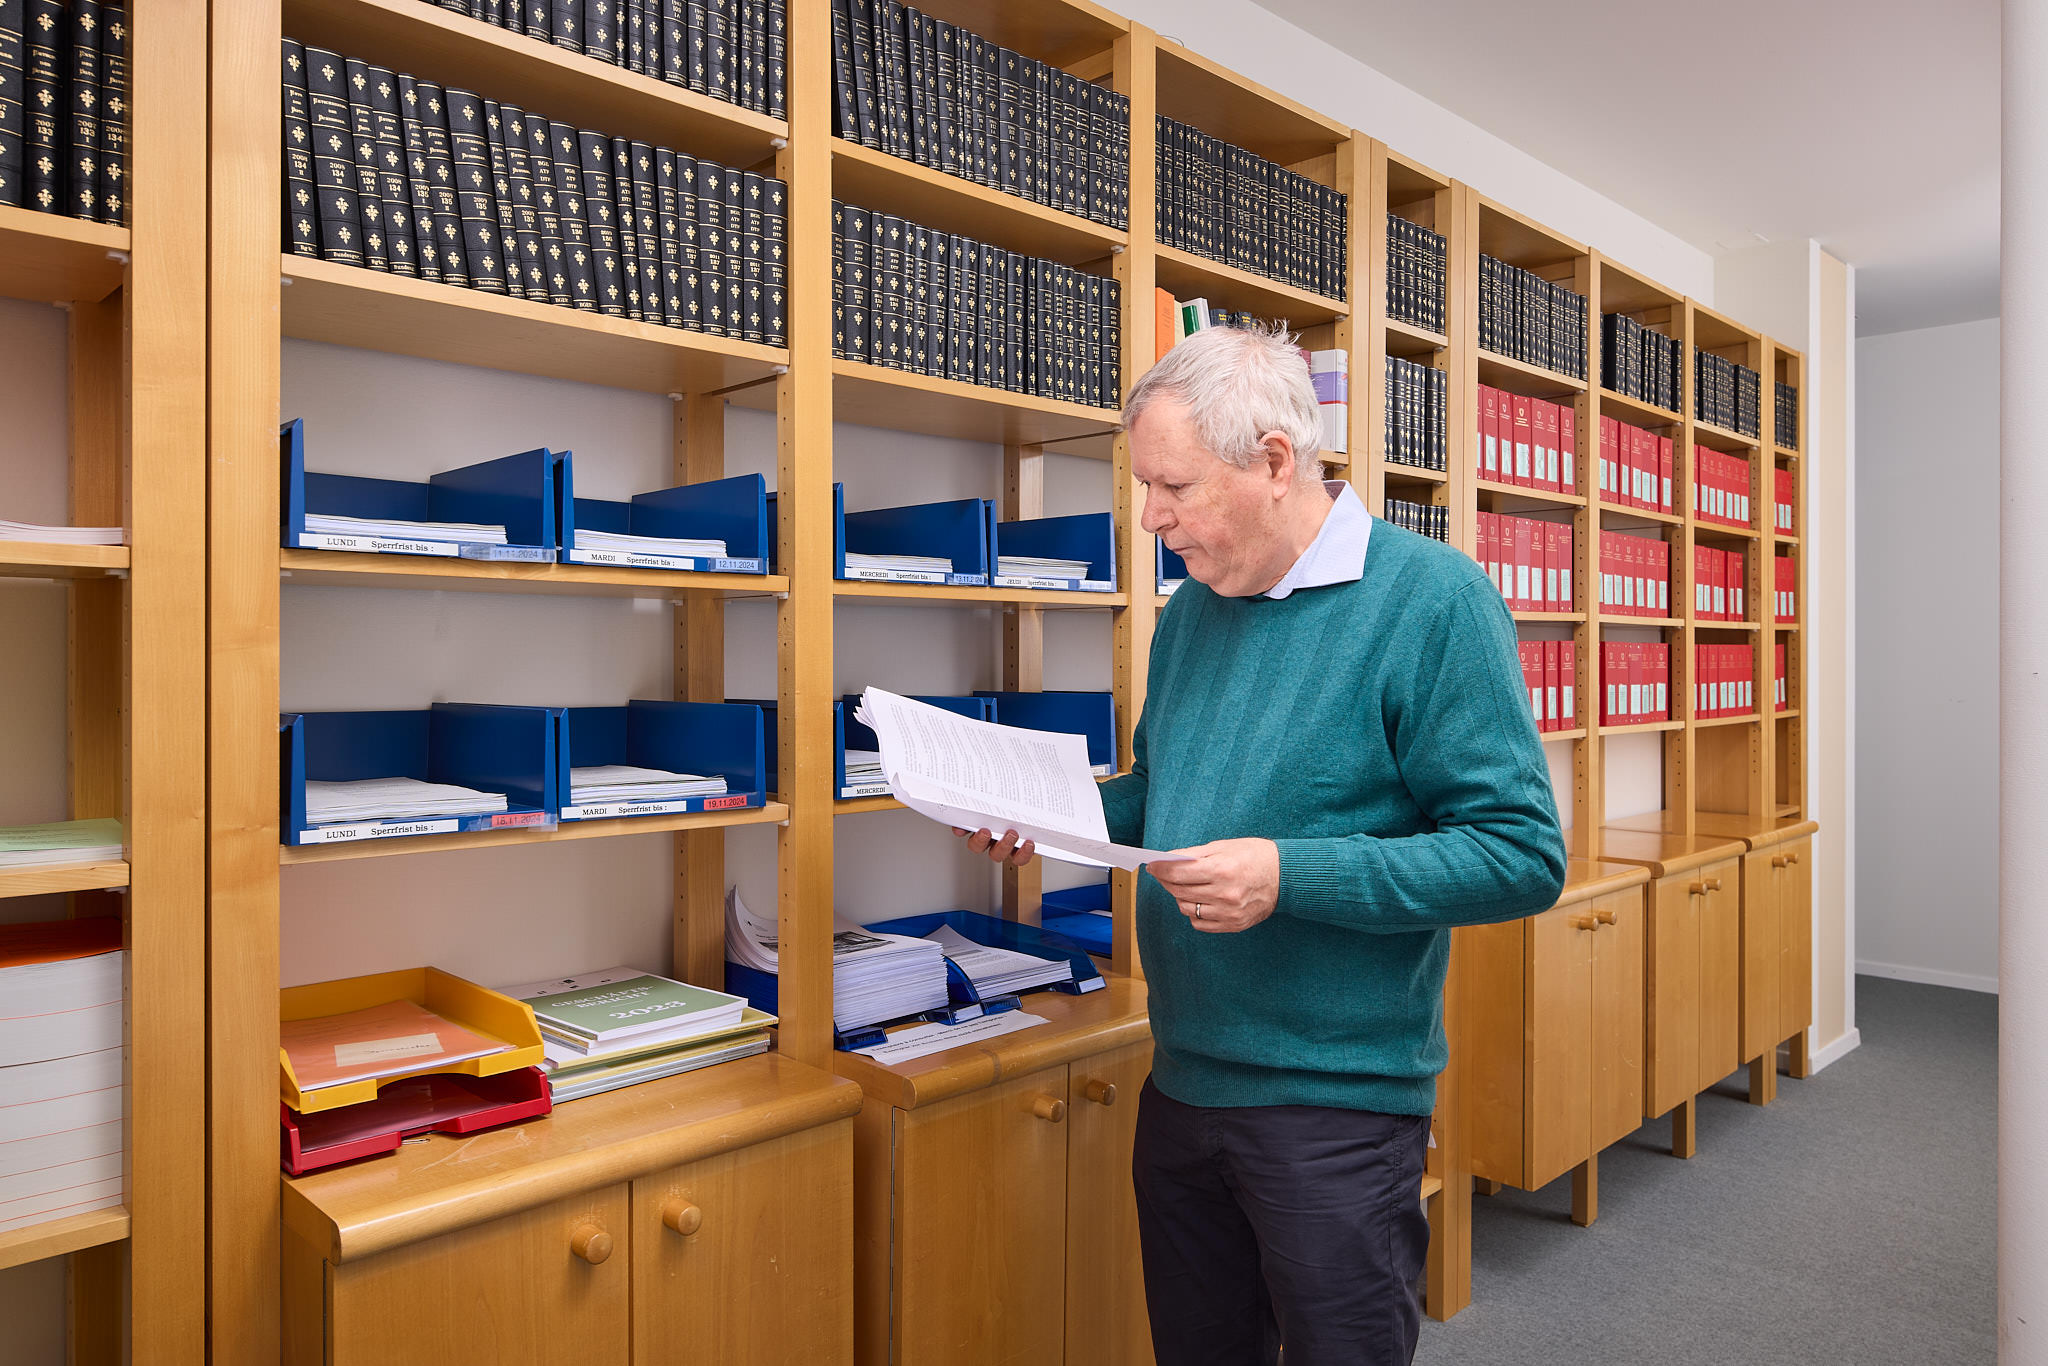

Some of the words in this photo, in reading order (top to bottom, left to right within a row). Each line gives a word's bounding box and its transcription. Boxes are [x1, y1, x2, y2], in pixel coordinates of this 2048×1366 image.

[37, 126, 54, 137] 133
[79, 126, 95, 137] 133
[327, 538, 357, 547] LUNDI
[371, 541, 413, 551] Sperrfrist
[416, 543, 428, 552] bis
[591, 553, 616, 562] MARDI
[626, 556, 659, 566] Sperrfrist
[660, 558, 670, 566] bis
[718, 560, 755, 569] 12.11.2024
[708, 798, 745, 808] 19.11.2024
[582, 808, 607, 816] MARDI
[618, 805, 651, 815] Sperrfrist
[326, 829, 357, 839] LUNDI
[370, 825, 413, 836] Sperrfrist
[415, 823, 430, 832] bis
[577, 992, 649, 1008] BERICHT
[609, 1001, 686, 1018] 2023
